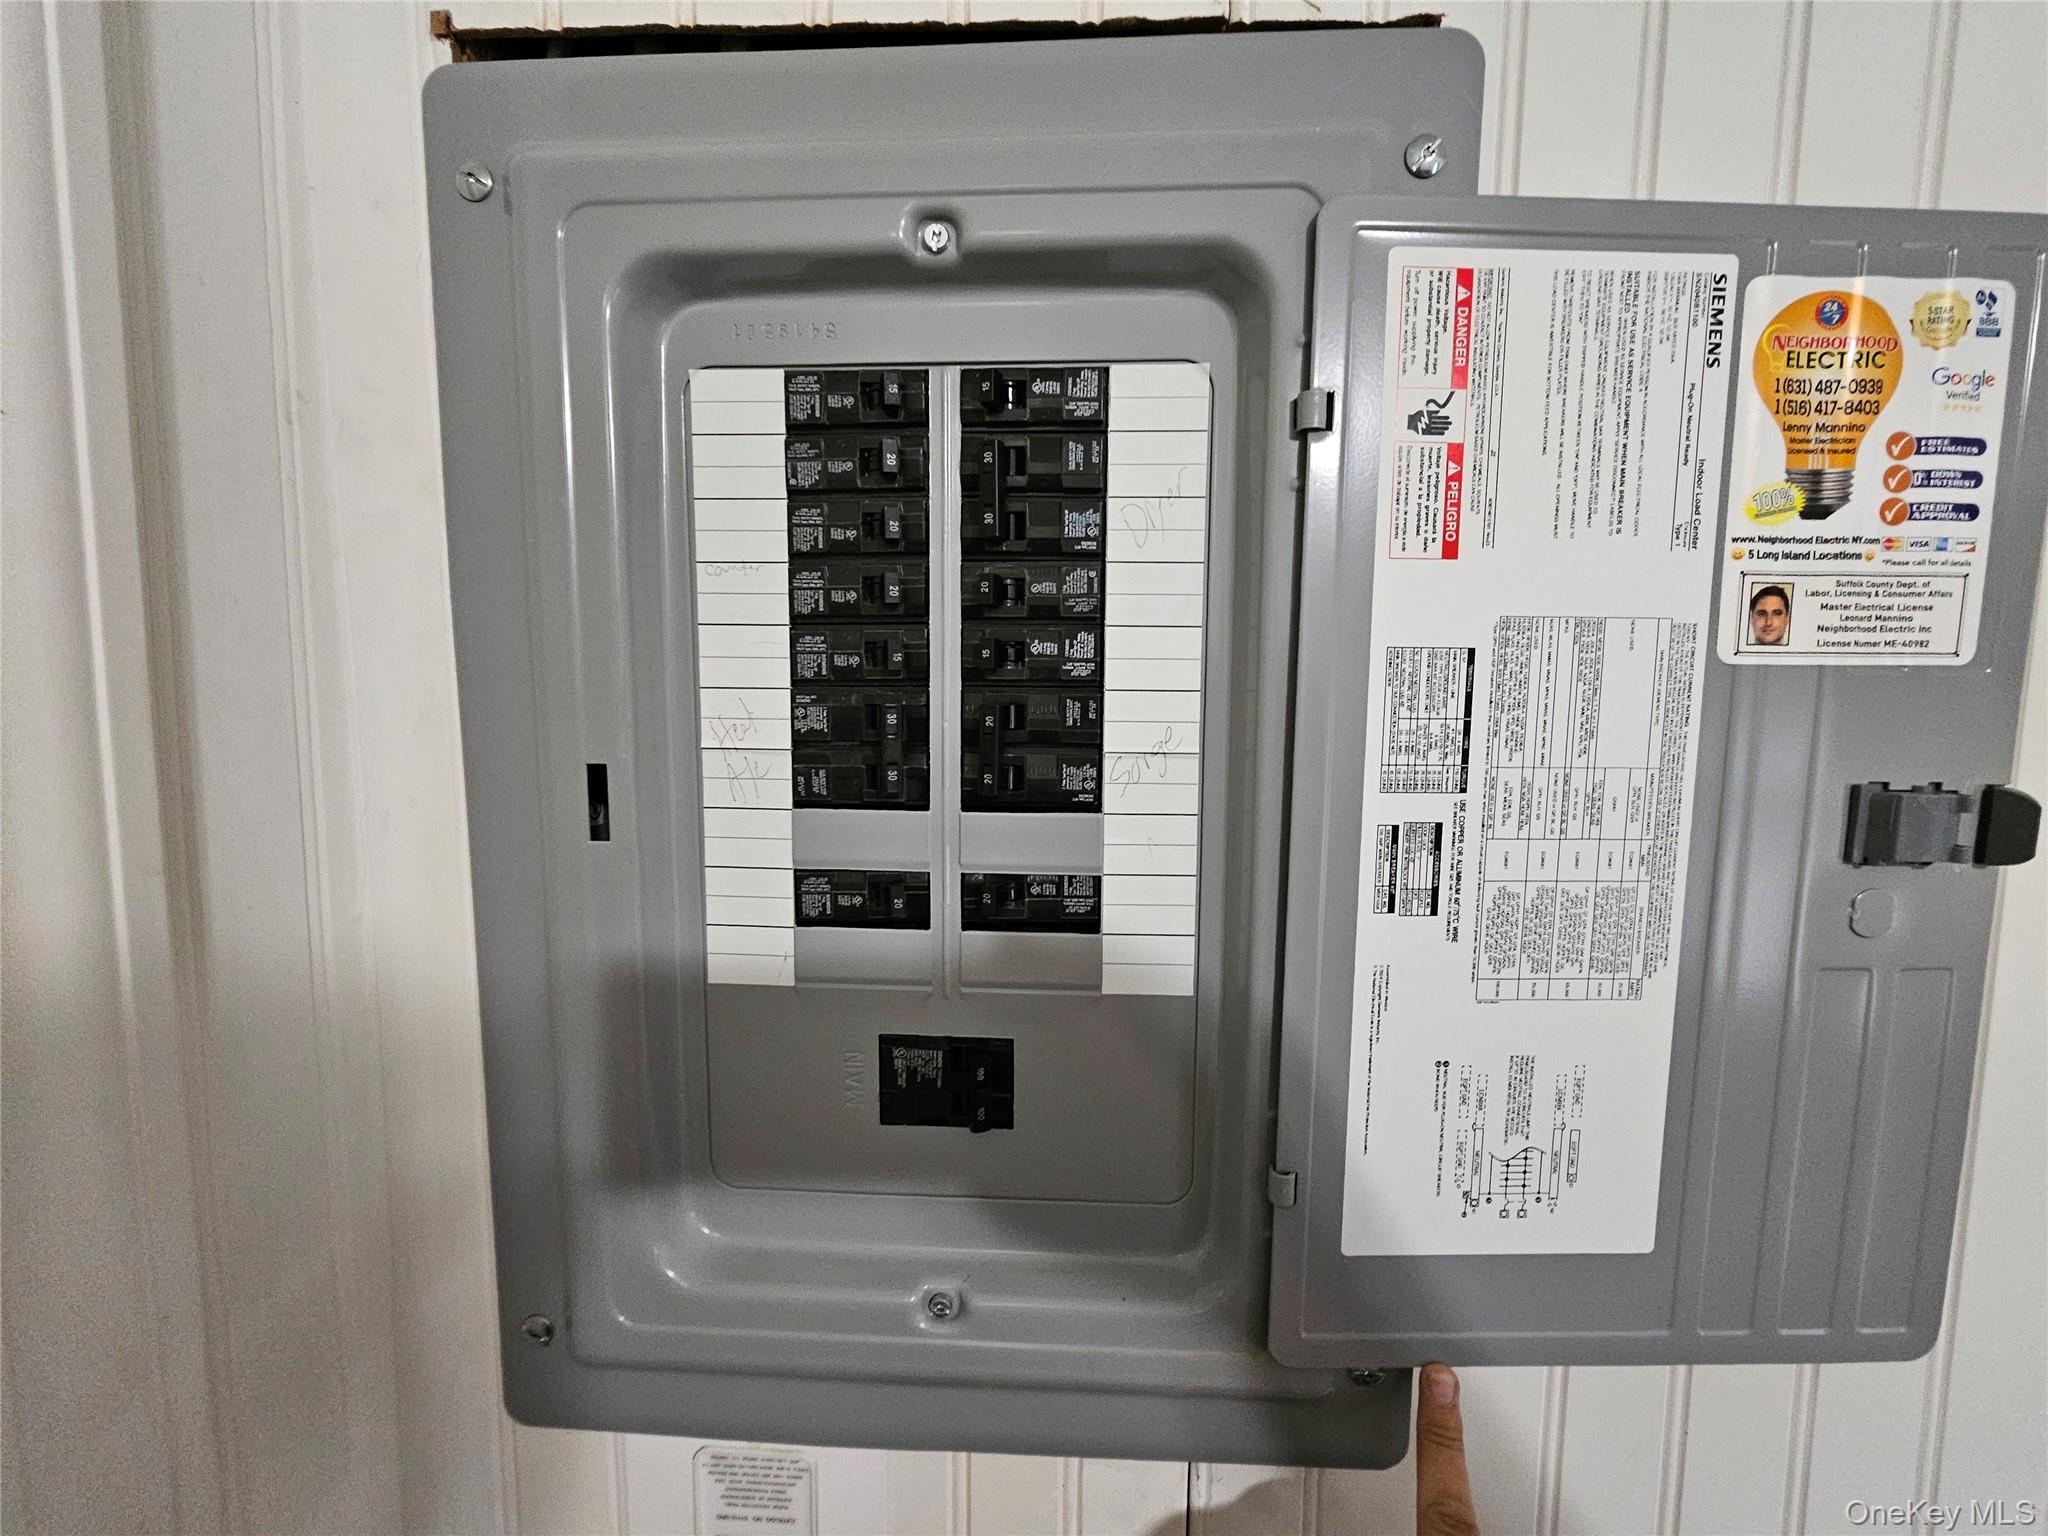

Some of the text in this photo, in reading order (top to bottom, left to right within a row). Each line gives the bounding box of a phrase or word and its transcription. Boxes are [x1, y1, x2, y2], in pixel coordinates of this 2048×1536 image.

[1632, 271, 1641, 308] SUITABLE
[1824, 302, 1839, 311] 24
[1630, 311, 1638, 327] FOR
[1706, 273, 1728, 369] SIEMENS
[1832, 315, 1840, 324] 7
[1979, 317, 1999, 326] BBB
[1454, 307, 1469, 367] DANGER
[1628, 329, 1636, 345] USE
[1628, 348, 1635, 357] AS
[1786, 350, 1887, 369] ELECTRIC
[1625, 360, 1634, 392] SERVICE
[1932, 367, 1995, 391] Google
[889, 384, 899, 393] 15
[982, 381, 990, 391] 15
[1775, 377, 1883, 396] 1 (631) 487-0939
[1775, 398, 1880, 417] 1 (516) 417-8403
[1622, 395, 1632, 440] EQUIPMENT
[1685, 415, 1694, 441] Neutral
[1782, 421, 1865, 434] Lenny Mannino
[887, 453, 897, 465] 20
[984, 452, 993, 463] 30
[1620, 442, 1628, 465] WHEN
[1682, 444, 1692, 466] Ready
[1690, 459, 1706, 550] Indoor Load Center
[1753, 486, 1795, 512] 100%
[1445, 481, 1458, 542] PELIGRO
[1616, 489, 1626, 525] BREAKER
[984, 513, 993, 524] 30
[889, 520, 899, 532] 20
[1616, 527, 1622, 535] IS
[1674, 524, 1682, 540] Type
[1909, 540, 1929, 548] VISA
[1749, 550, 1862, 561] 5 Long Island Locations
[889, 585, 899, 597] 20
[980, 581, 989, 592] 20
[1866, 581, 1893, 590] County
[1835, 590, 1872, 598] Licensing
[1820, 603, 1852, 611] Master
[1854, 603, 1894, 611] Electrical
[1817, 625, 1932, 634] Neighborhood Electric Inc
[1817, 639, 1851, 648] License
[1884, 640, 1930, 648] ME-40982
[893, 653, 902, 662] 15
[982, 649, 990, 658] 15
[887, 713, 897, 724] 30
[985, 716, 994, 727] 20
[888, 770, 897, 781] 30
[984, 774, 993, 784] 20
[1459, 800, 1467, 813] USE
[1457, 816, 1466, 844] COPPER
[1456, 846, 1464, 857] OR
[1454, 859, 1463, 895] ALUMINUM
[894, 898, 903, 909] 20
[983, 893, 991, 904] 20
[1452, 926, 1460, 944] WIRE
